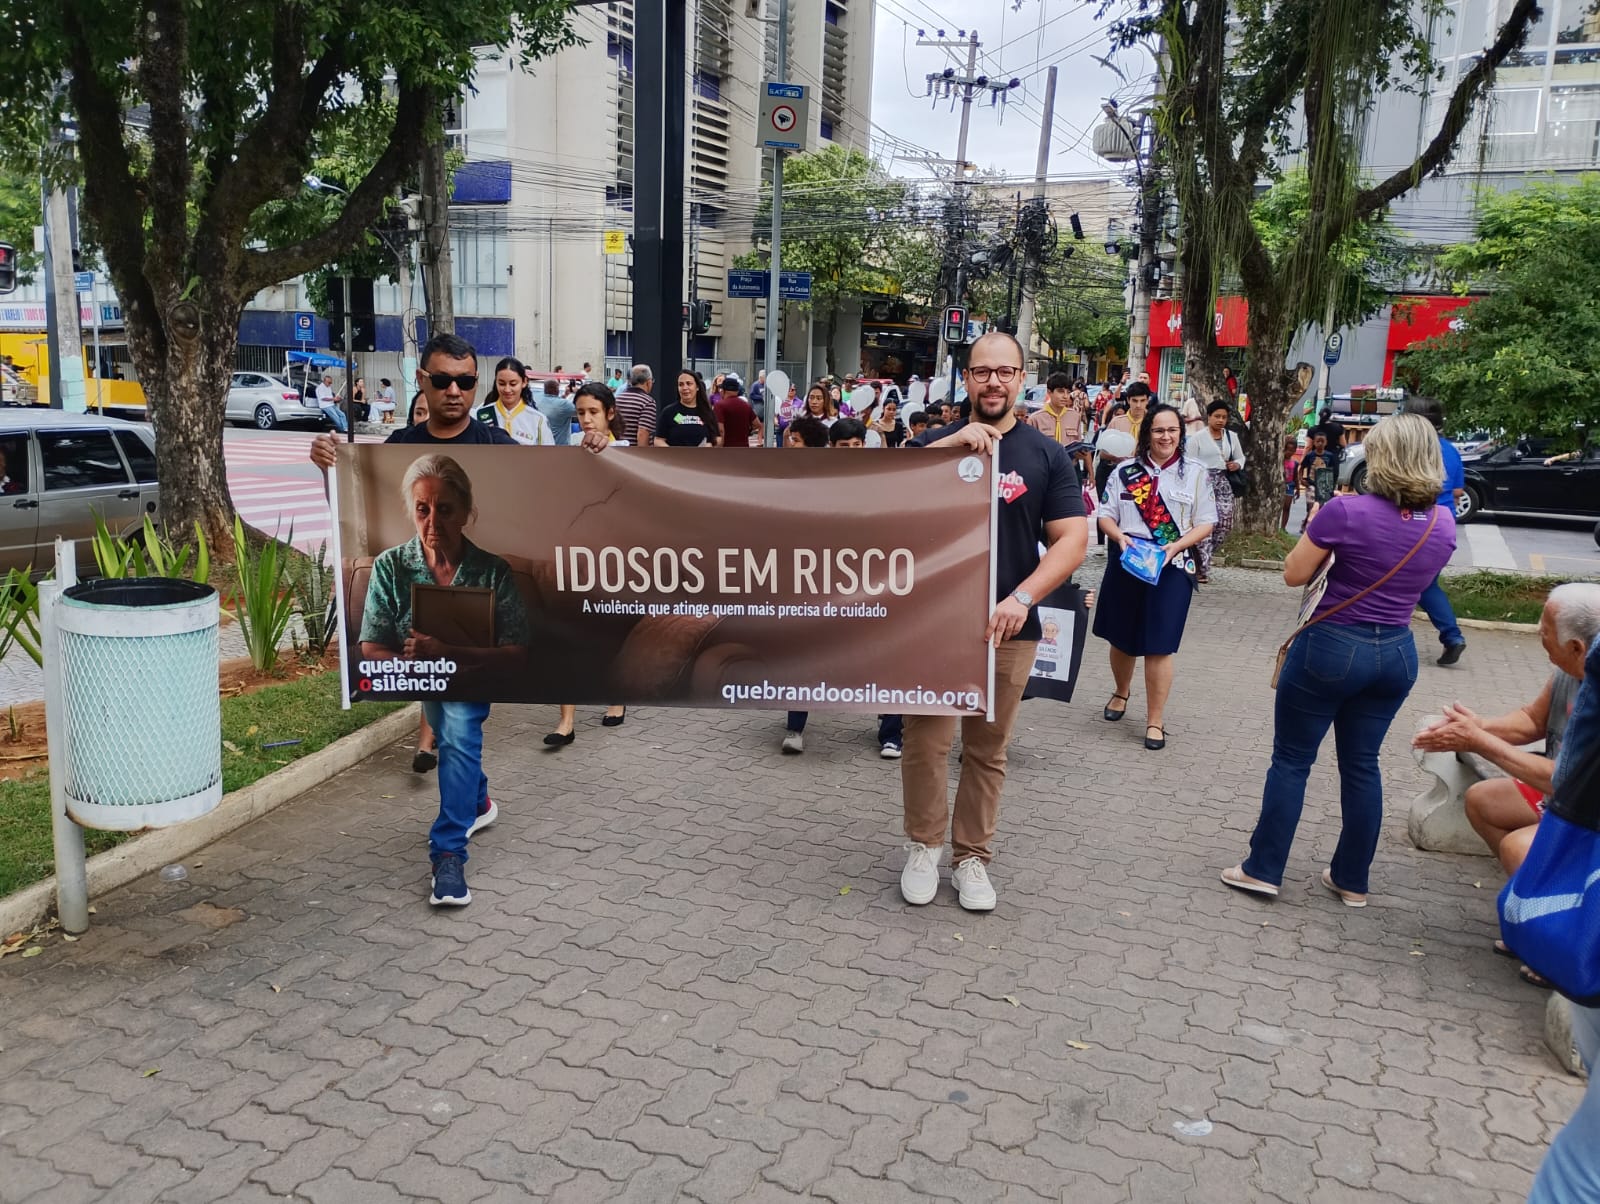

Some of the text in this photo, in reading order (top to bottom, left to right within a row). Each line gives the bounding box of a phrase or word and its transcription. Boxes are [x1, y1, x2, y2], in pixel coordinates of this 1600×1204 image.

[301, 317, 309, 327] E
[1331, 336, 1338, 347] E
[555, 546, 915, 596] IDOSOS EM RISCO
[582, 599, 887, 619] A violência que atinge quem mais precisa de cuidado
[359, 657, 457, 677] quebrando
[721, 680, 980, 710] quebrandoosilencio.org
